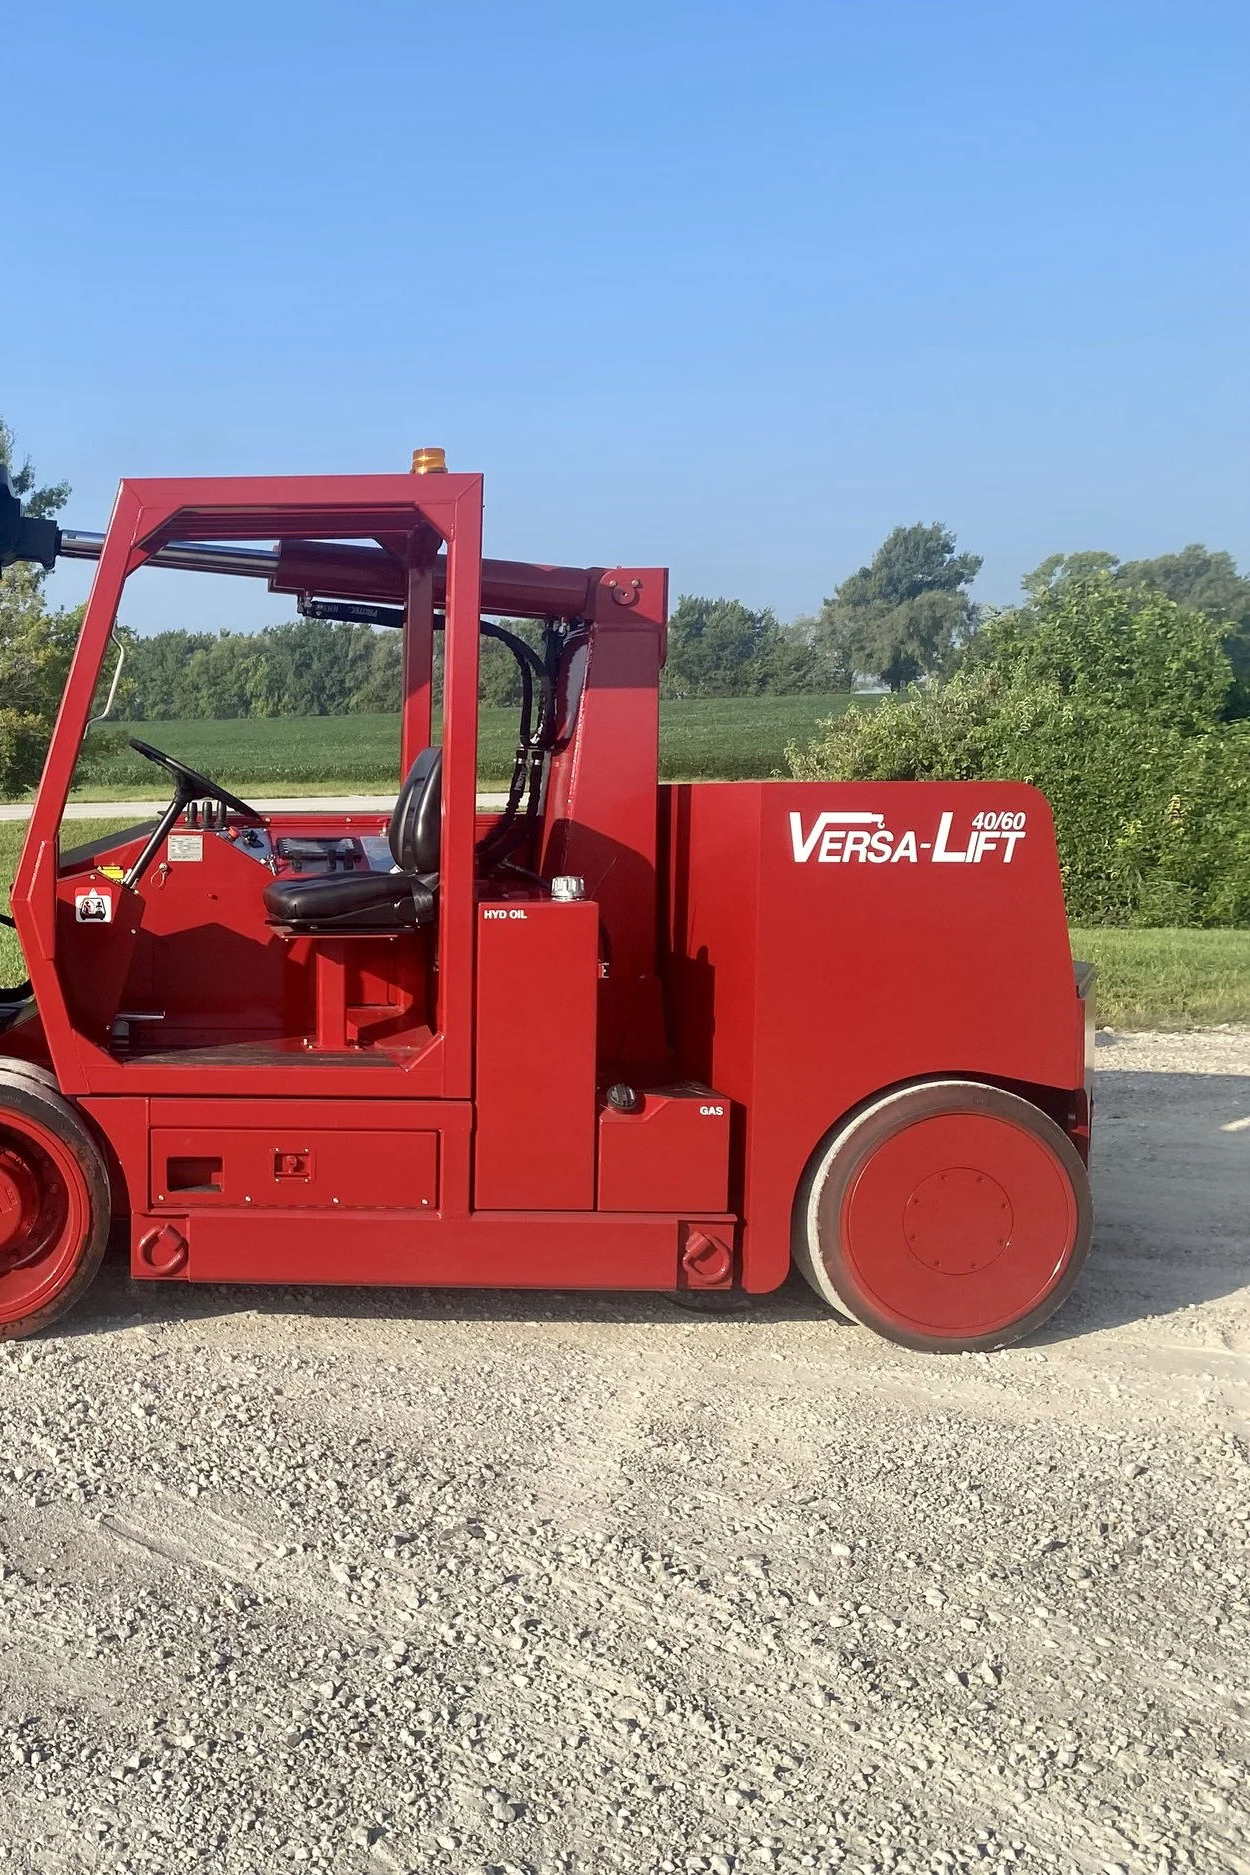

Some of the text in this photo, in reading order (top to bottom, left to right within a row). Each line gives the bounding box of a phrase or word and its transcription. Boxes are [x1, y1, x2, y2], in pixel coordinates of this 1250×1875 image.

[971, 811, 1027, 830] 40/60
[788, 811, 1027, 864] VERSA-LIFT
[483, 909, 528, 919] HYD OIL
[699, 1105, 724, 1116] GAS
